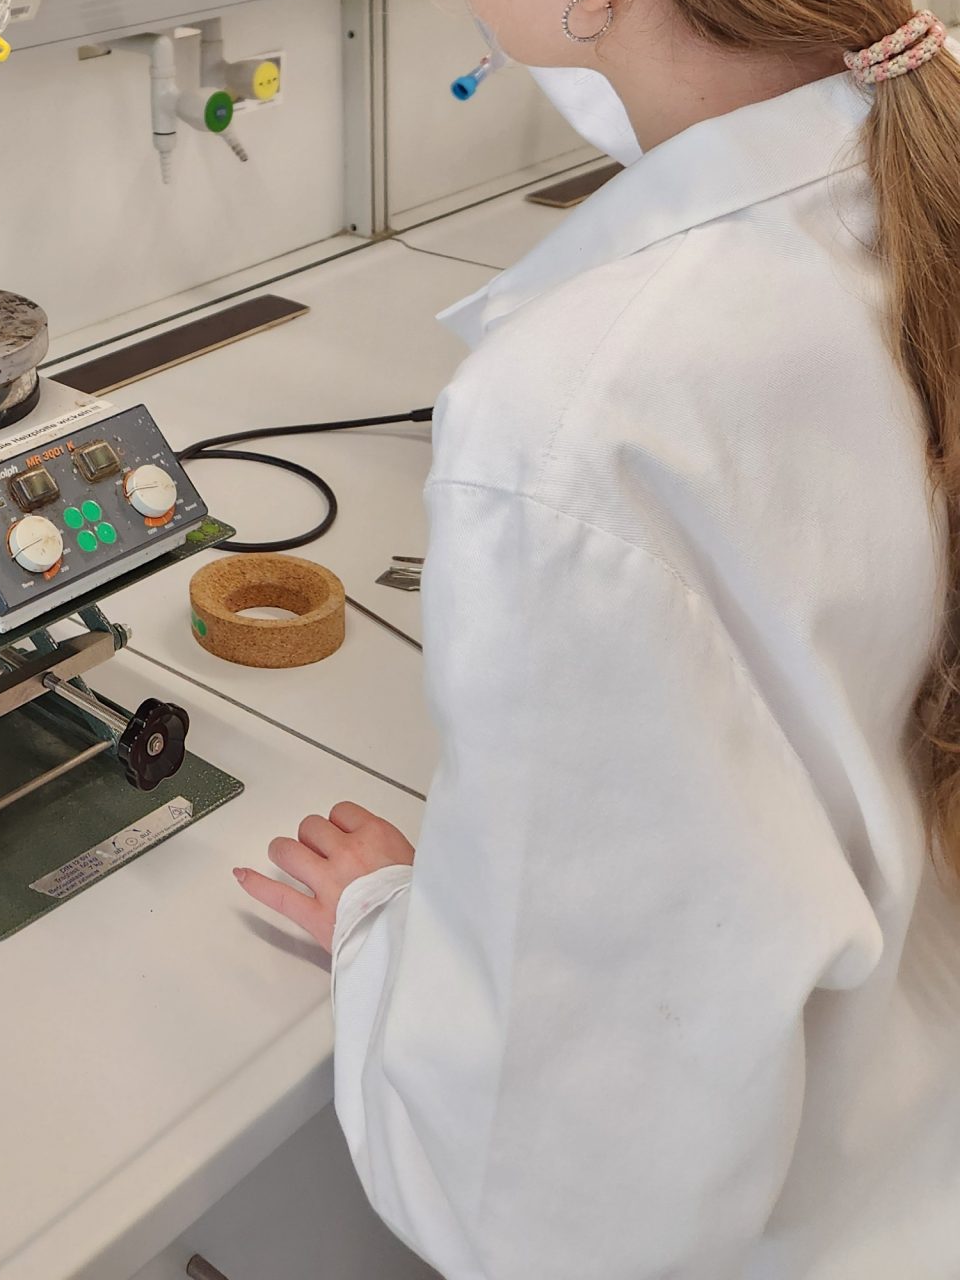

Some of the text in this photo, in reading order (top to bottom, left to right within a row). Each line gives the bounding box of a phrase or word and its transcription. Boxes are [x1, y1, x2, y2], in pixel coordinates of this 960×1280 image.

[11, 421, 57, 445] Heizplatte
[56, 406, 92, 425] wickeln
[24, 438, 75, 468] MR 3001 K
